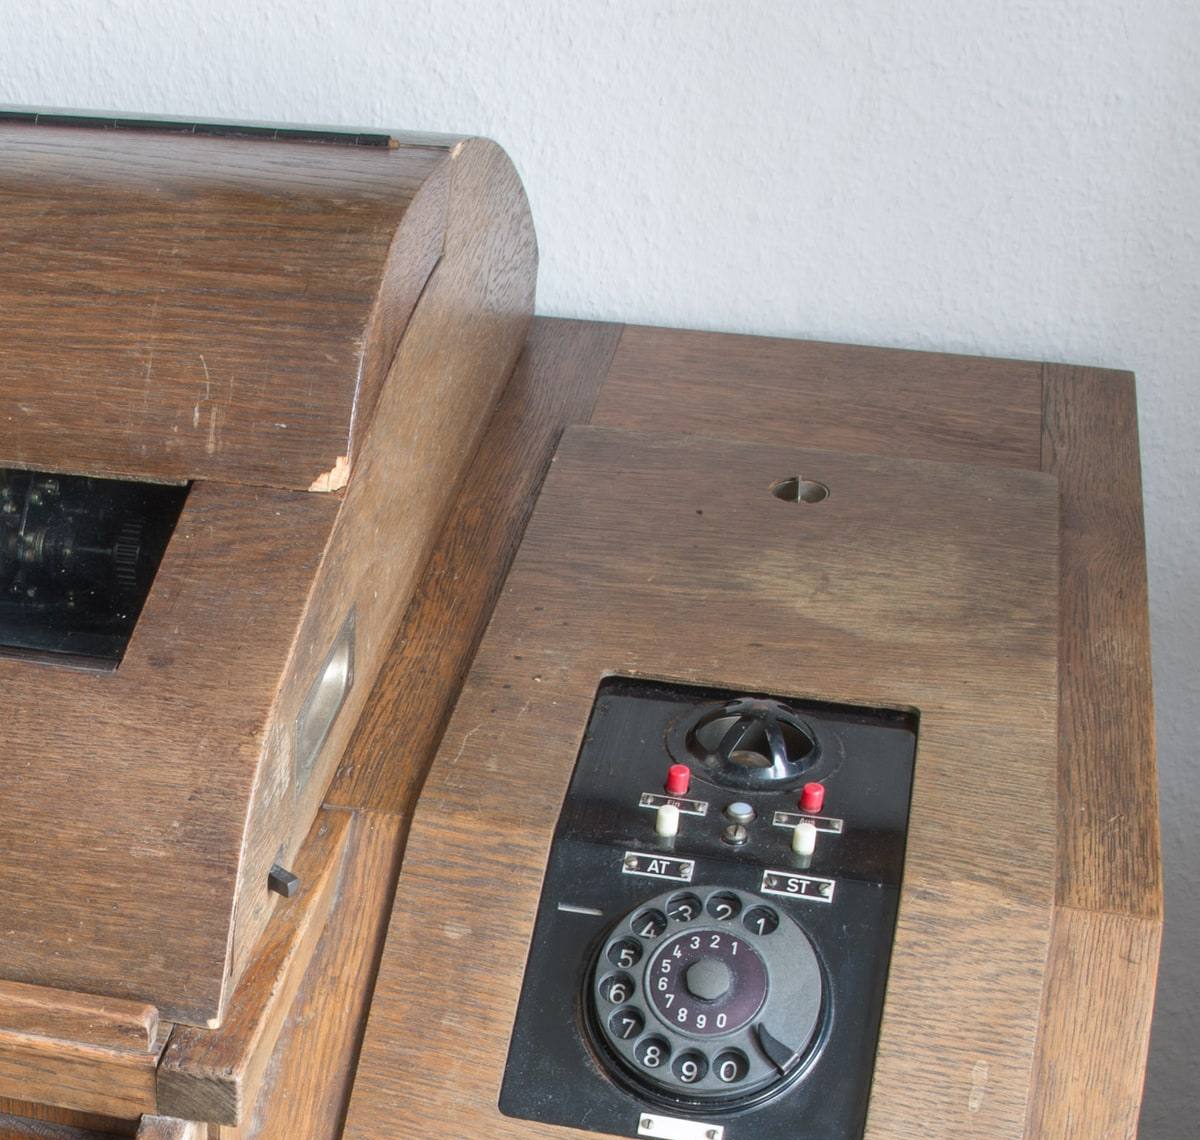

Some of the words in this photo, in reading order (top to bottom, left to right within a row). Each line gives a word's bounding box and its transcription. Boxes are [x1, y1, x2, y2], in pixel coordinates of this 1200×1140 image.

[647, 859, 670, 875] AT
[786, 878, 811, 894] ST
[678, 904, 693, 922] 3
[715, 904, 732, 921] 2
[640, 920, 657, 939] 4
[756, 917, 766, 936] 1
[689, 936, 700, 949] 3
[709, 935, 721, 949] 2
[731, 941, 738, 956] 1
[617, 949, 635, 968] 5
[673, 945, 682, 959] 4
[661, 959, 671, 973] 5
[658, 977, 668, 990] 6
[609, 983, 626, 1004] 6
[665, 994, 675, 1008] 7
[677, 1007, 688, 1022] 8
[696, 1015, 707, 1029] 9
[716, 1013, 727, 1028] 0
[622, 1017, 636, 1039] 7
[643, 1047, 661, 1068] 8
[680, 1061, 698, 1083] 9
[720, 1060, 737, 1082] 0
